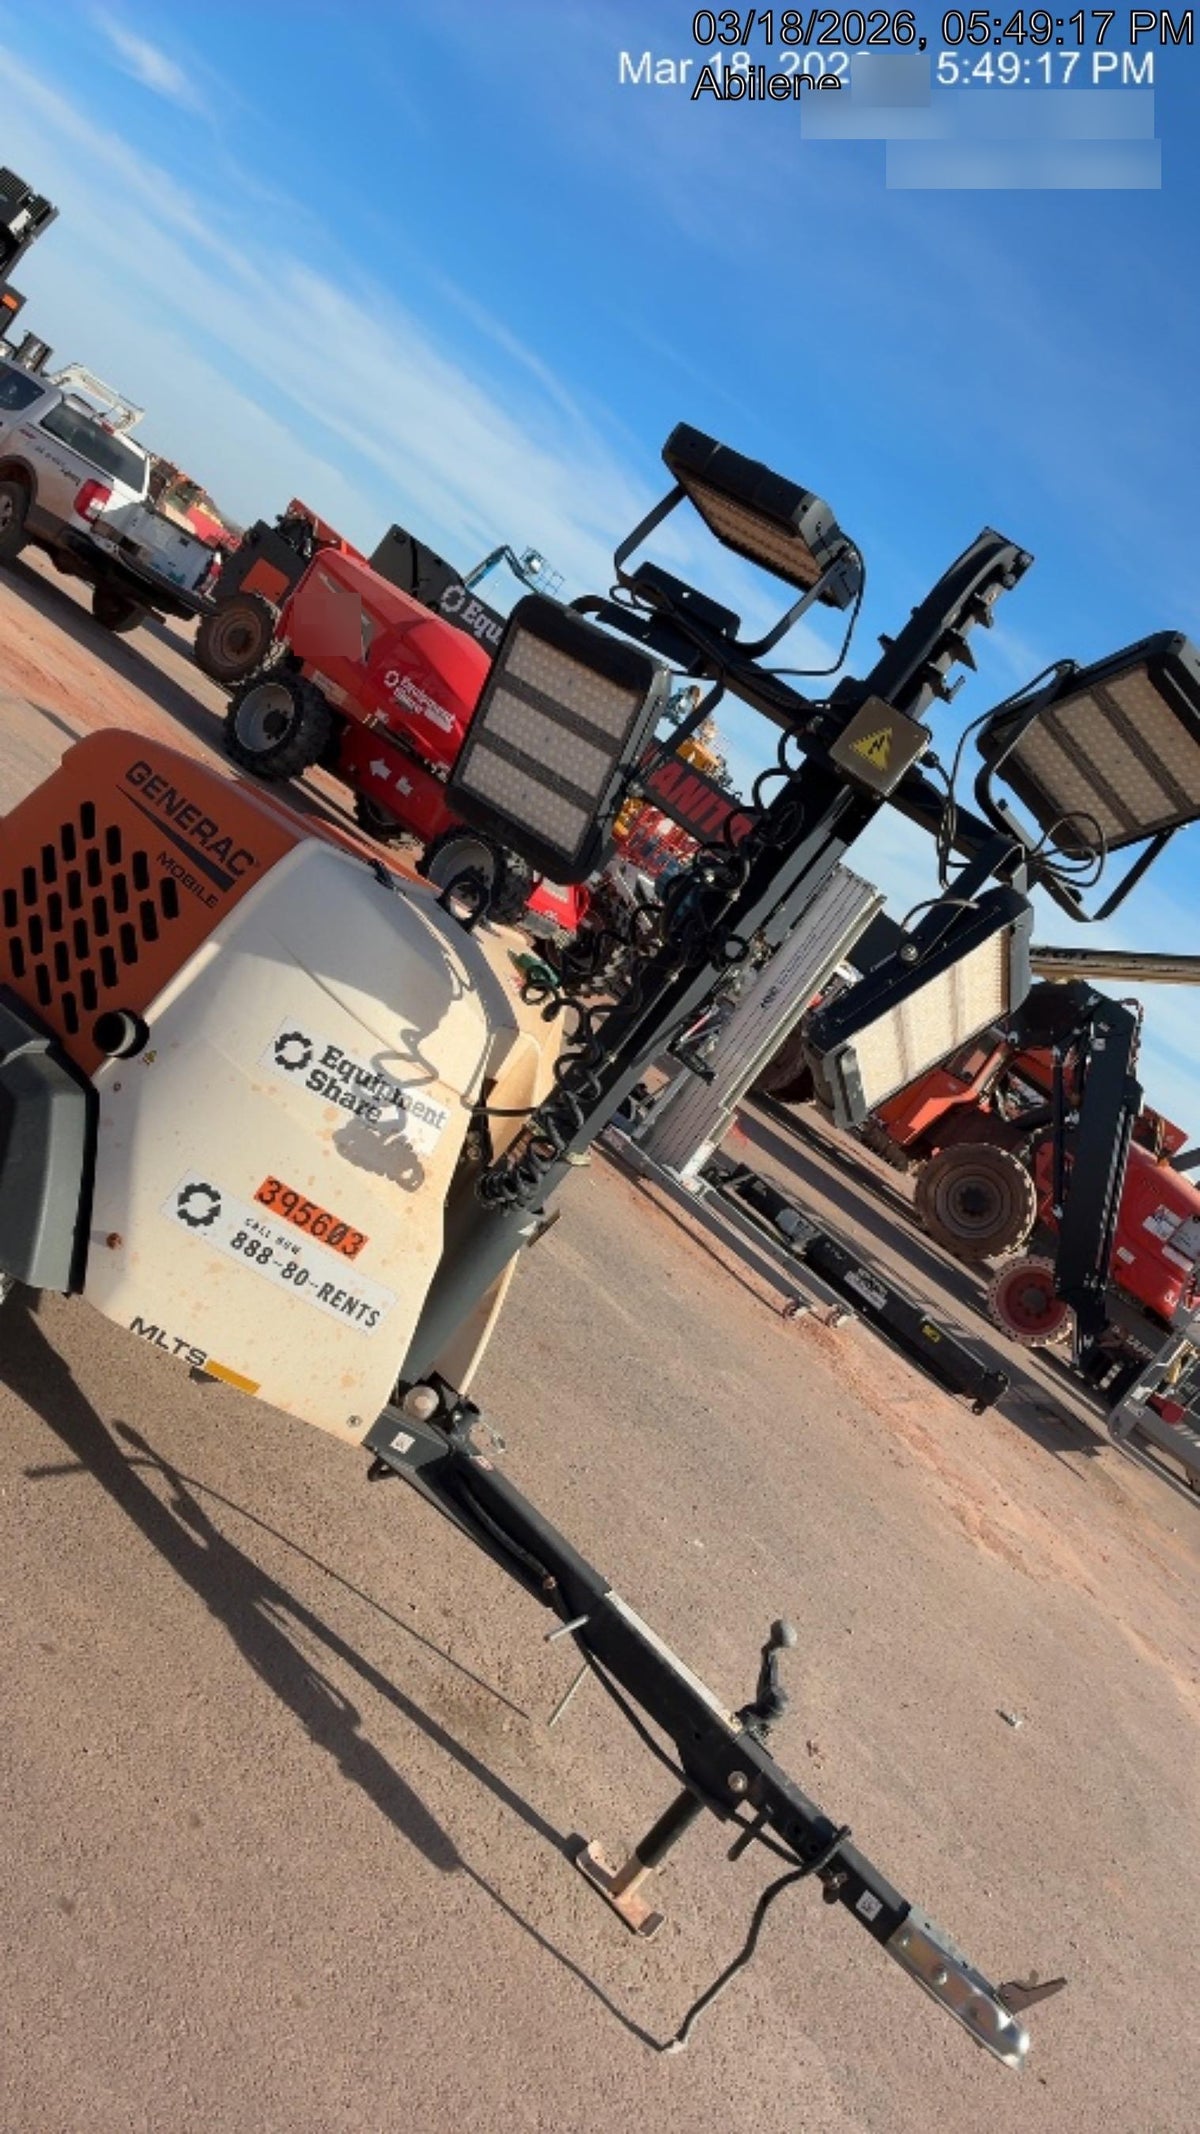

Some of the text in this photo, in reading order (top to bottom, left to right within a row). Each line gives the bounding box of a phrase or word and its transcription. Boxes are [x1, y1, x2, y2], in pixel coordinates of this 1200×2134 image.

[460, 599, 503, 646] Equ
[125, 760, 254, 878] GENERAC
[156, 851, 219, 909] MOBILE
[305, 1069, 382, 1124] Share
[317, 1045, 447, 1129] Equipment
[257, 1179, 364, 1256] 395603
[230, 1230, 380, 1328] 888-80-RENTS
[129, 1315, 207, 1367] MLTS
